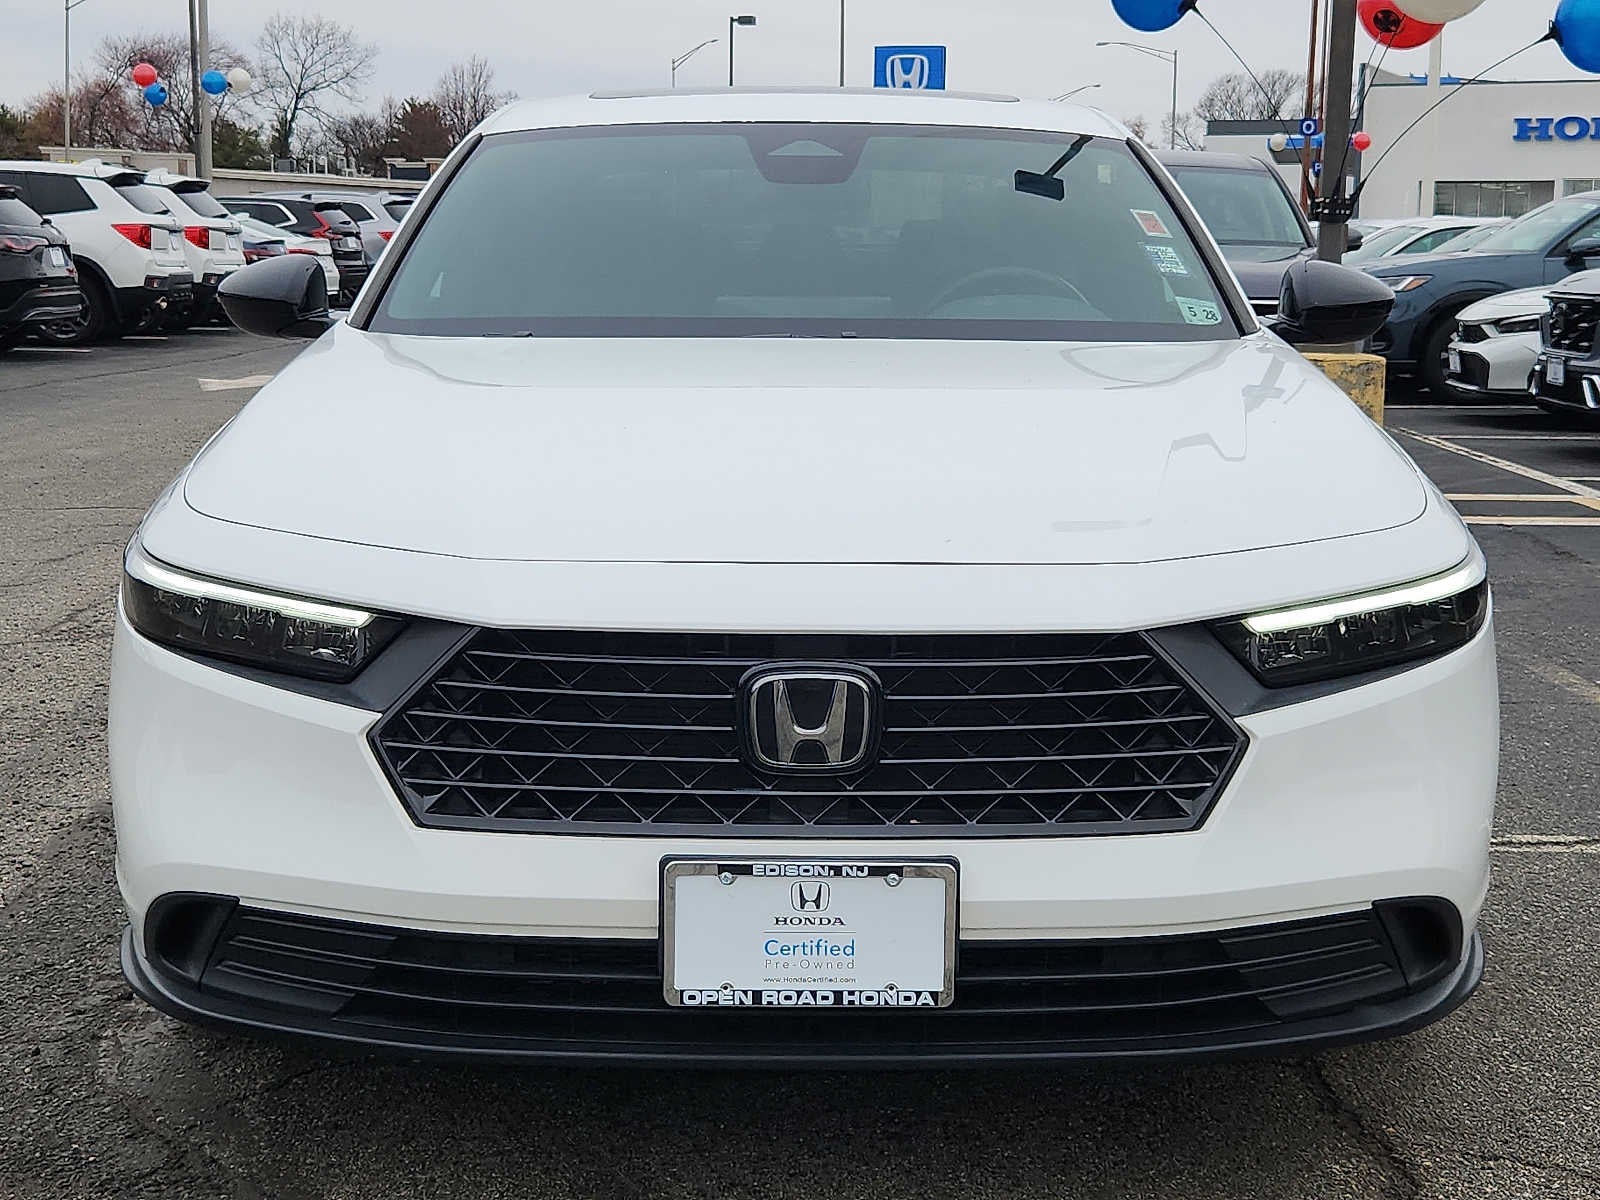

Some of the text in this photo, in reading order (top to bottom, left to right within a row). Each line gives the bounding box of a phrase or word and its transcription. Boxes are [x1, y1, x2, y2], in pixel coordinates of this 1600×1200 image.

[1513, 116, 1600, 141] HO
[1187, 306, 1218, 321] 5 28
[752, 864, 869, 878] EDISON, NJ
[774, 916, 846, 926] HONDA
[764, 938, 856, 957] Certified
[764, 959, 856, 970] Pre-Owned
[682, 990, 936, 1006] OPEN ROAD HONDA
